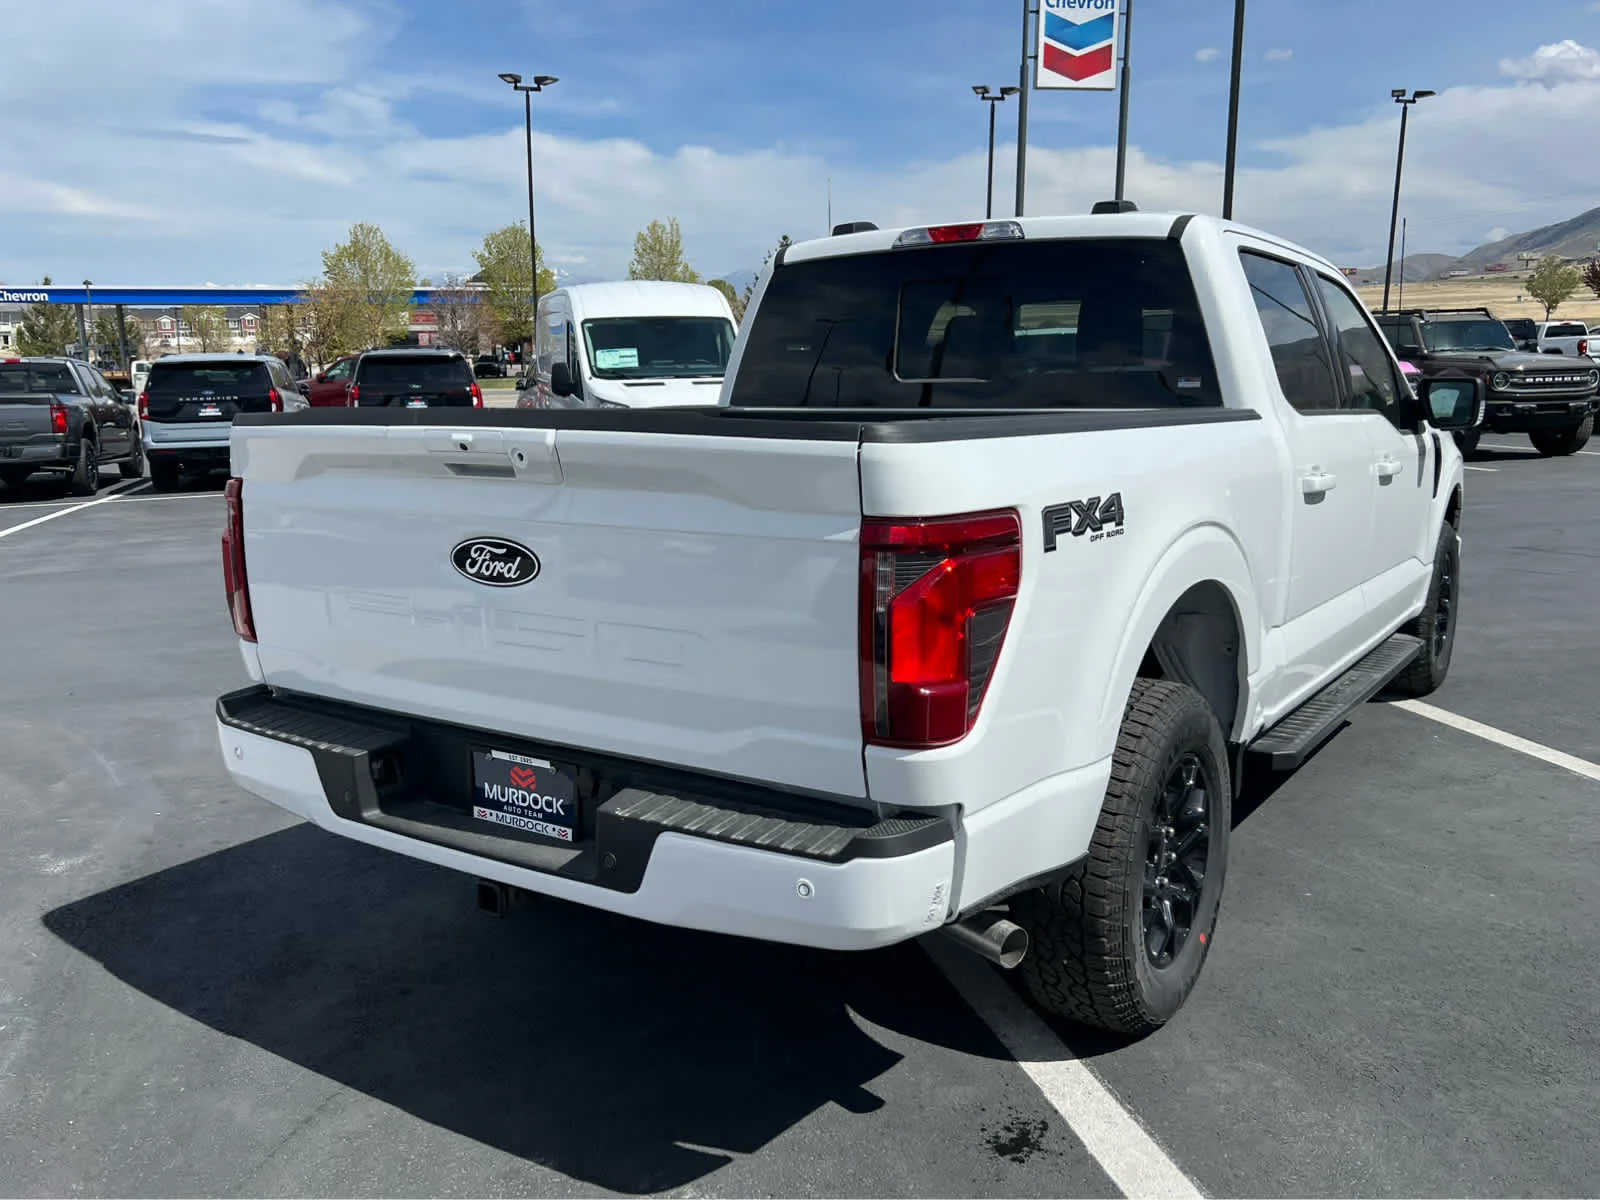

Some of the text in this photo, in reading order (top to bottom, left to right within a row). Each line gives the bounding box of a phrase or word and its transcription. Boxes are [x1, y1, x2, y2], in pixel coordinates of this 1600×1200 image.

[1041, 492, 1124, 553] FX4
[1090, 528, 1125, 542] OFF ROAD
[465, 544, 521, 579] Ford
[484, 782, 565, 815] MURDOCK
[503, 805, 543, 819] AUTO TEAM
[495, 813, 550, 834] MURDOCK
